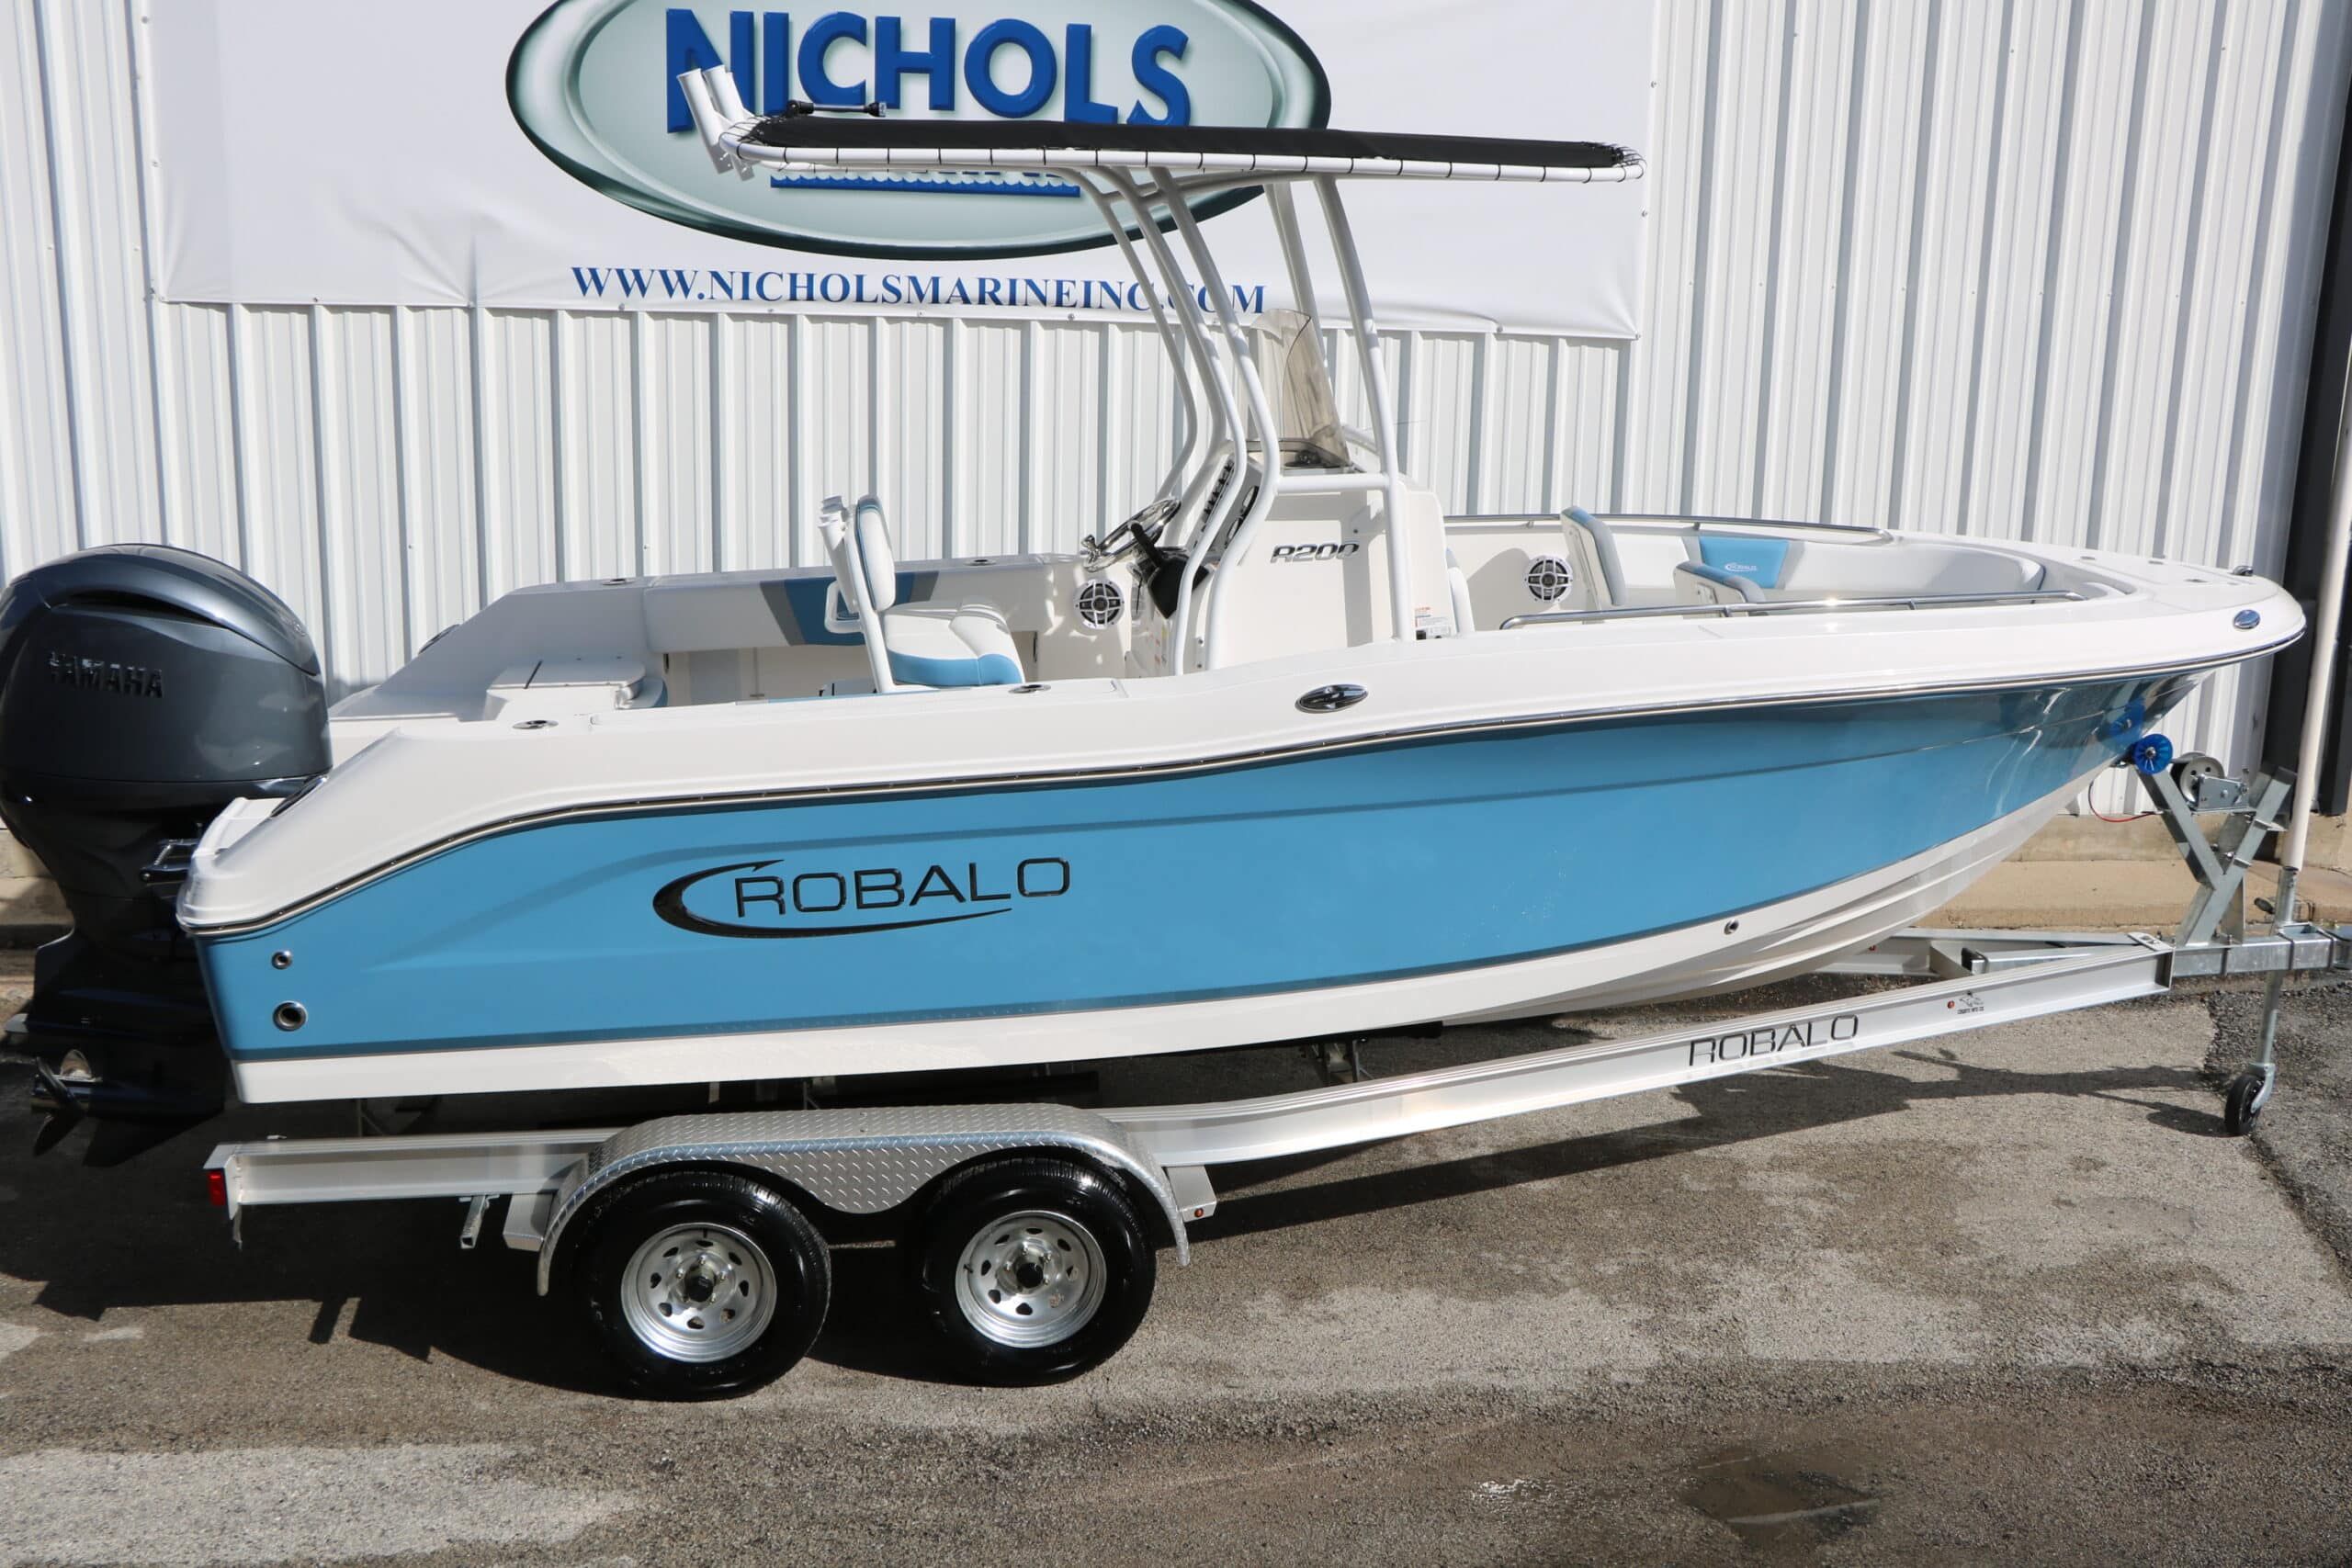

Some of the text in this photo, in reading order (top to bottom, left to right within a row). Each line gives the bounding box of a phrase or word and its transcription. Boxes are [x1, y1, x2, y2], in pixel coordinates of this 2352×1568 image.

[666, 7, 1191, 133] NICHOLS
[1270, 542, 1360, 563] R200
[734, 857, 1070, 918] ROBALO
[1689, 1014, 1859, 1066] ROBALO
